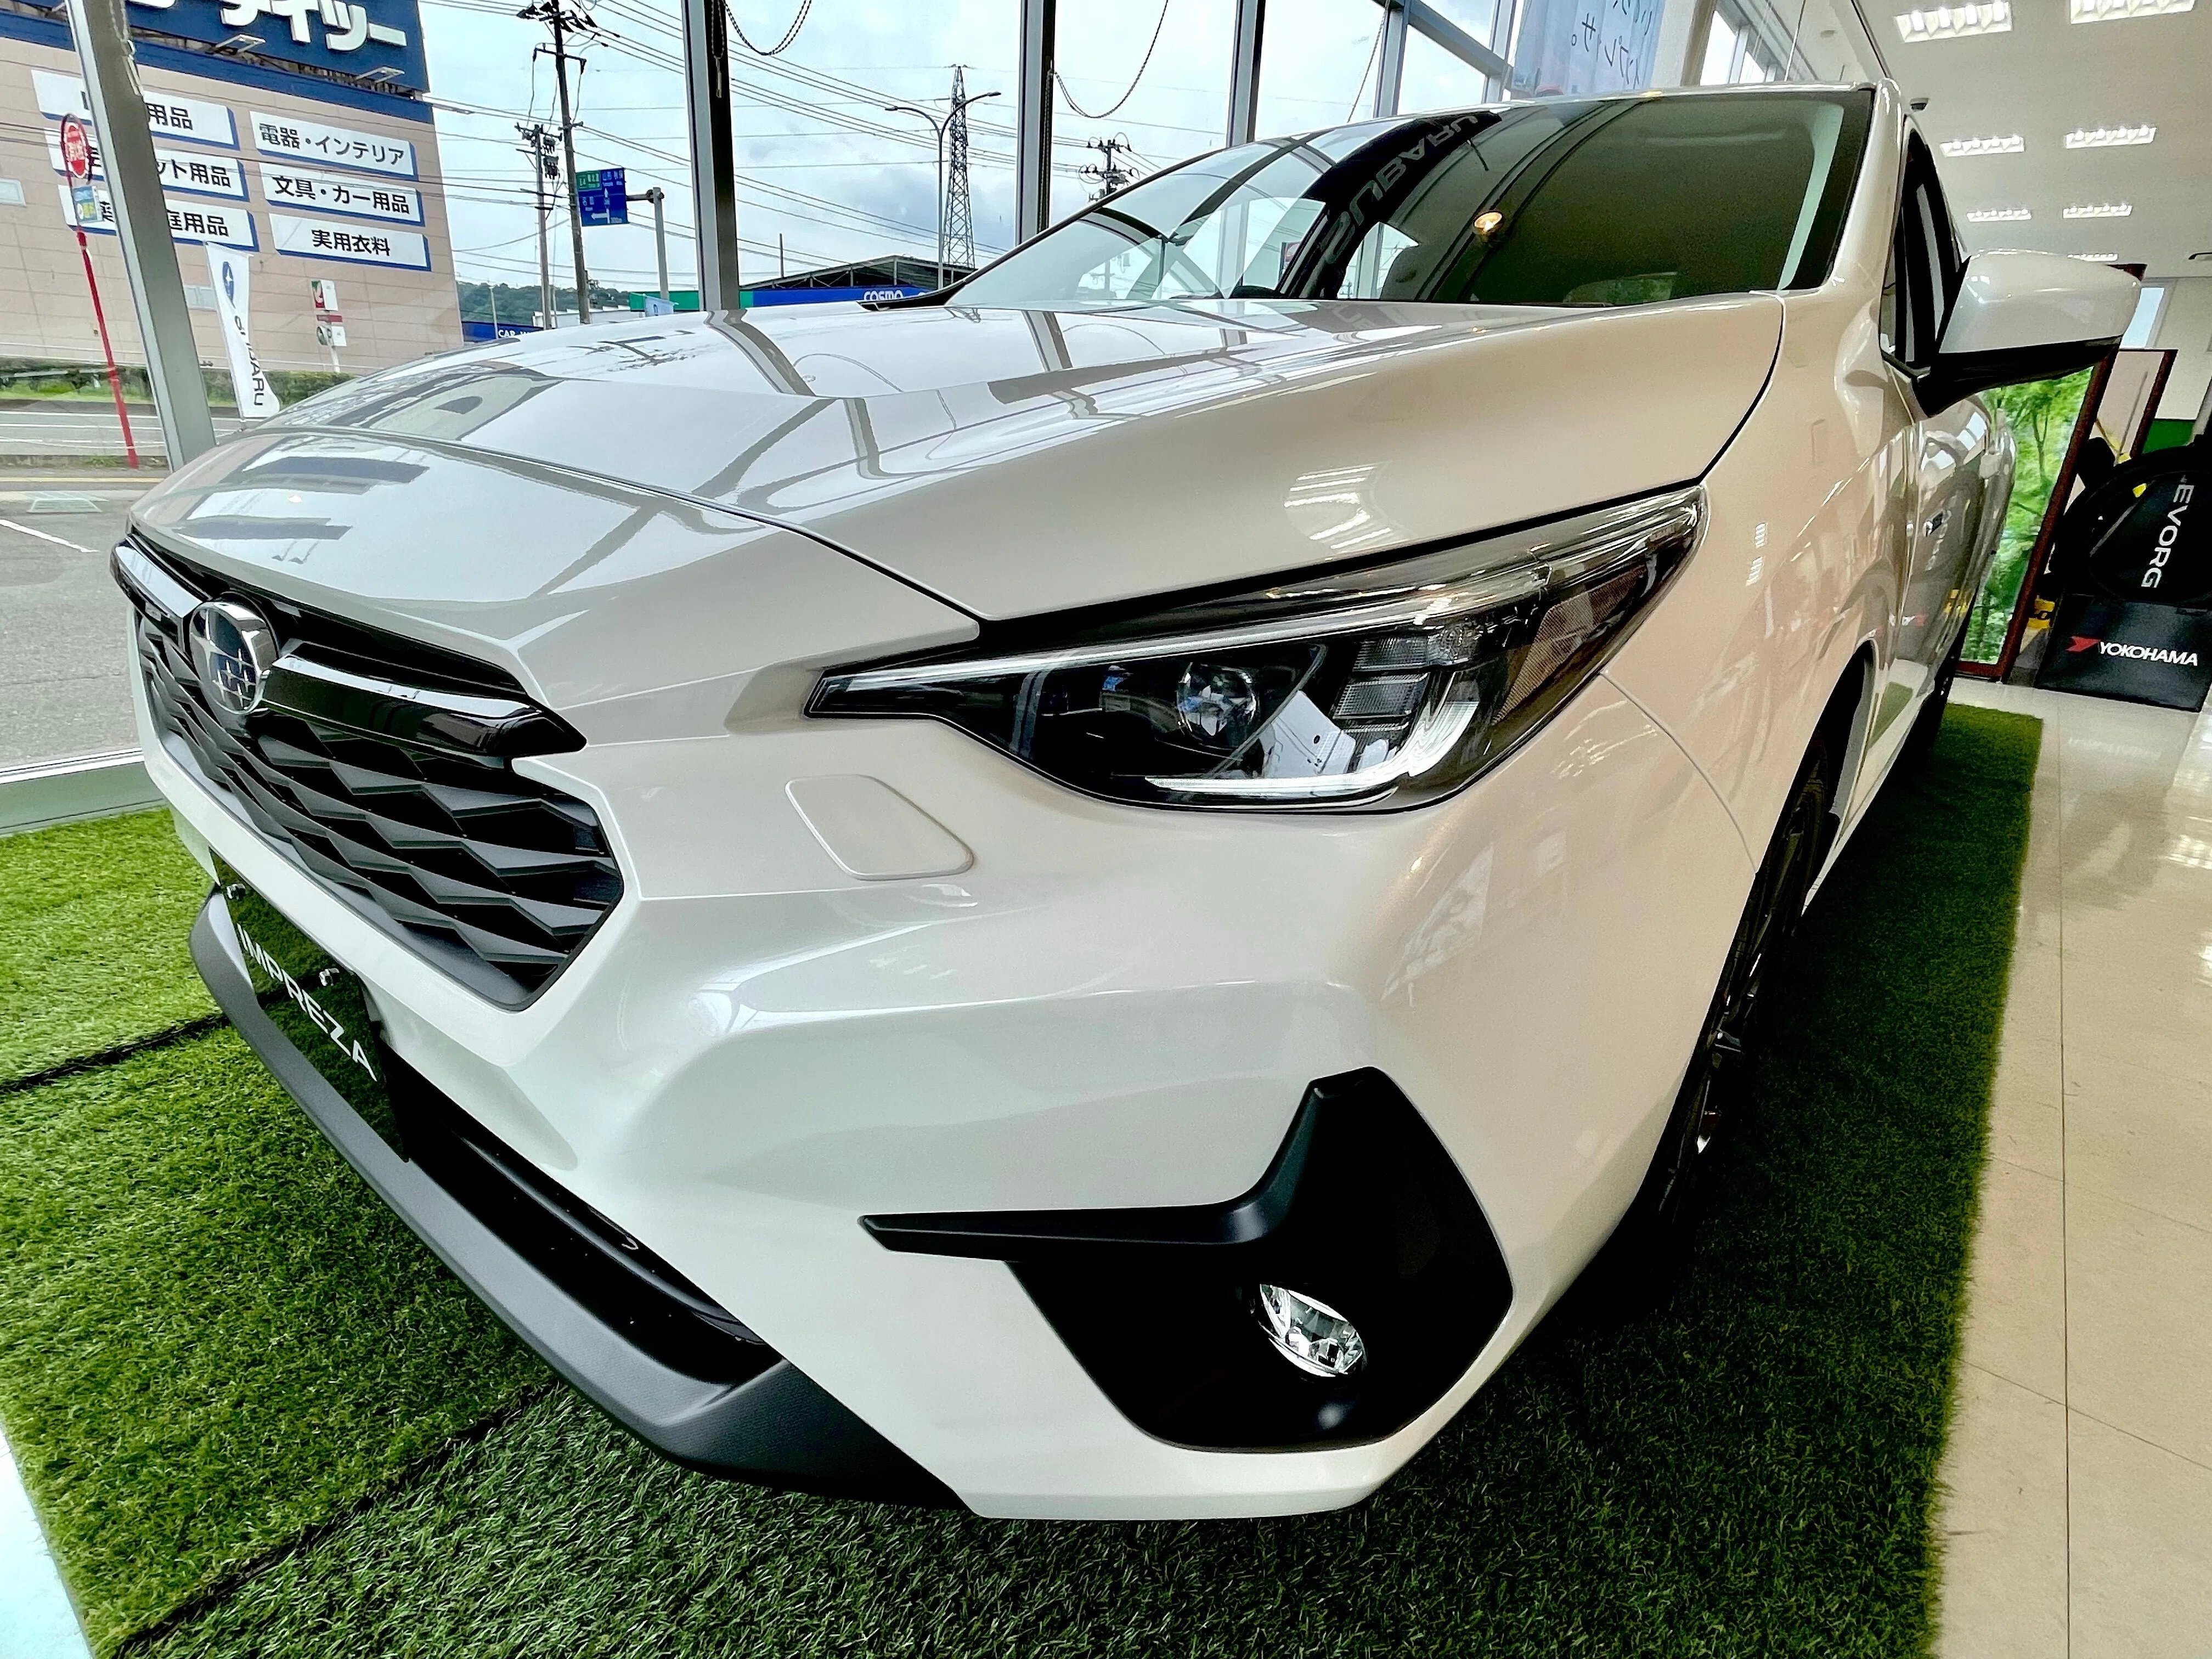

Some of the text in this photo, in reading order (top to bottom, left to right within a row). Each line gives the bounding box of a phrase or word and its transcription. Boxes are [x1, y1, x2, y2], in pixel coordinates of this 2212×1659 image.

[259, 122, 404, 165] 電器・インテリア
[272, 176, 409, 214] 文具・カー用品
[312, 229, 390, 256] 実用衣料
[864, 290, 904, 301] COSMO
[234, 315, 264, 406] SARU
[2100, 641, 2198, 666] YOKOHAMA
[237, 923, 377, 1082] IMPREZA
